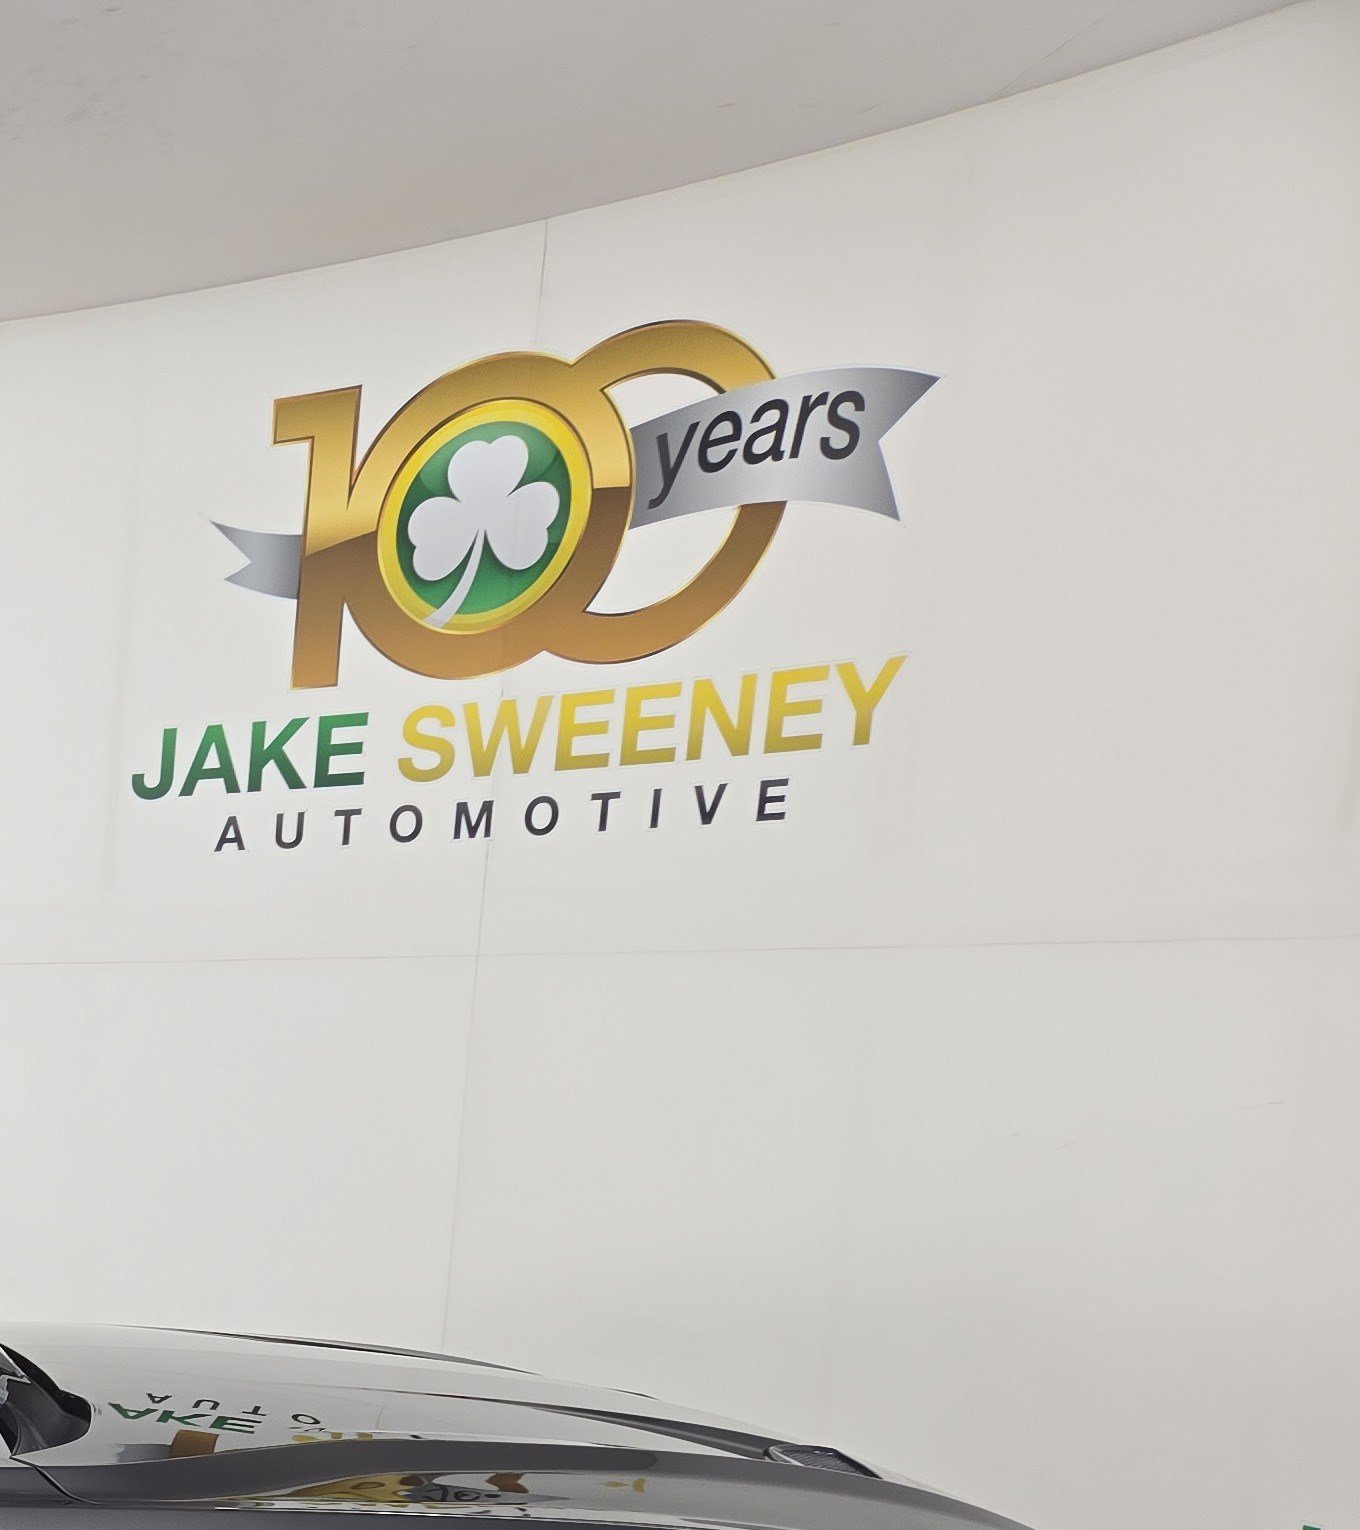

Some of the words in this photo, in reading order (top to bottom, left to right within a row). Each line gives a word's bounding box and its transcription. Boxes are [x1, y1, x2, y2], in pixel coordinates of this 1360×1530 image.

[273, 319, 787, 689] 100
[648, 389, 866, 510] years
[131, 711, 370, 802] JAKE
[397, 655, 909, 783] SWEENEY
[214, 778, 791, 853] AUTOMOTIVE
